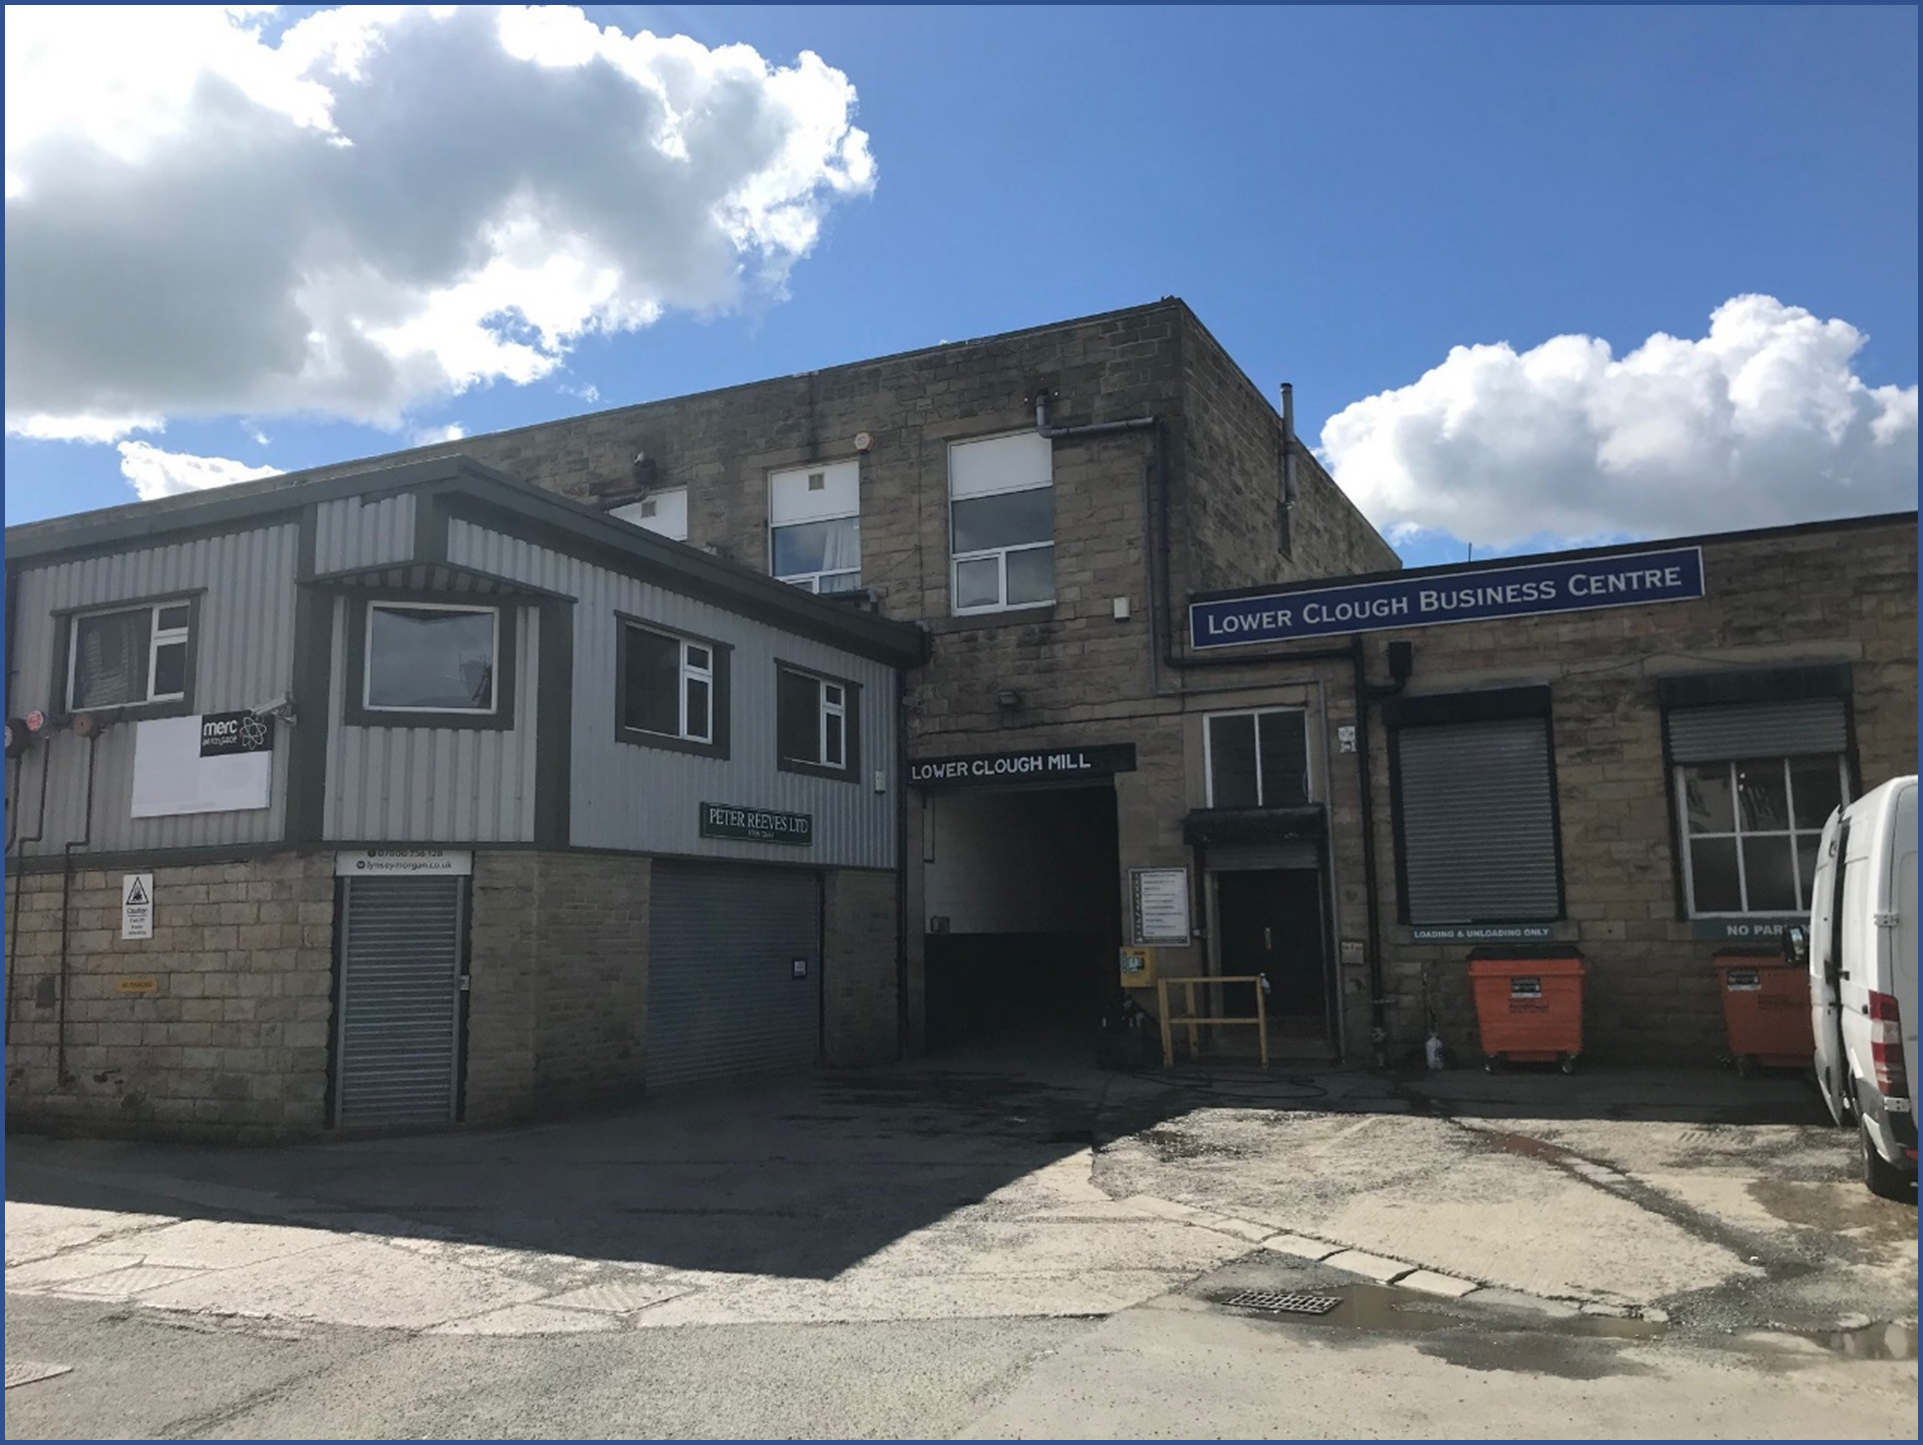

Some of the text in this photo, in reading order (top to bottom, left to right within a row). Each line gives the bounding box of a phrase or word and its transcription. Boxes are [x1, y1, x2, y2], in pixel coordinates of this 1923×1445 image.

[1208, 566, 1682, 635] LOWER CLOUGH BUSINESS CENTRE
[203, 720, 238, 736] merc
[911, 753, 1092, 780] LOWER CLOUGH MILL
[709, 808, 746, 828] PETER
[747, 812, 788, 832] REEVES
[789, 817, 810, 834] LTD
[1413, 927, 1550, 939] LOADING & UNLOADING ONLY
[1726, 924, 1750, 936] NO
